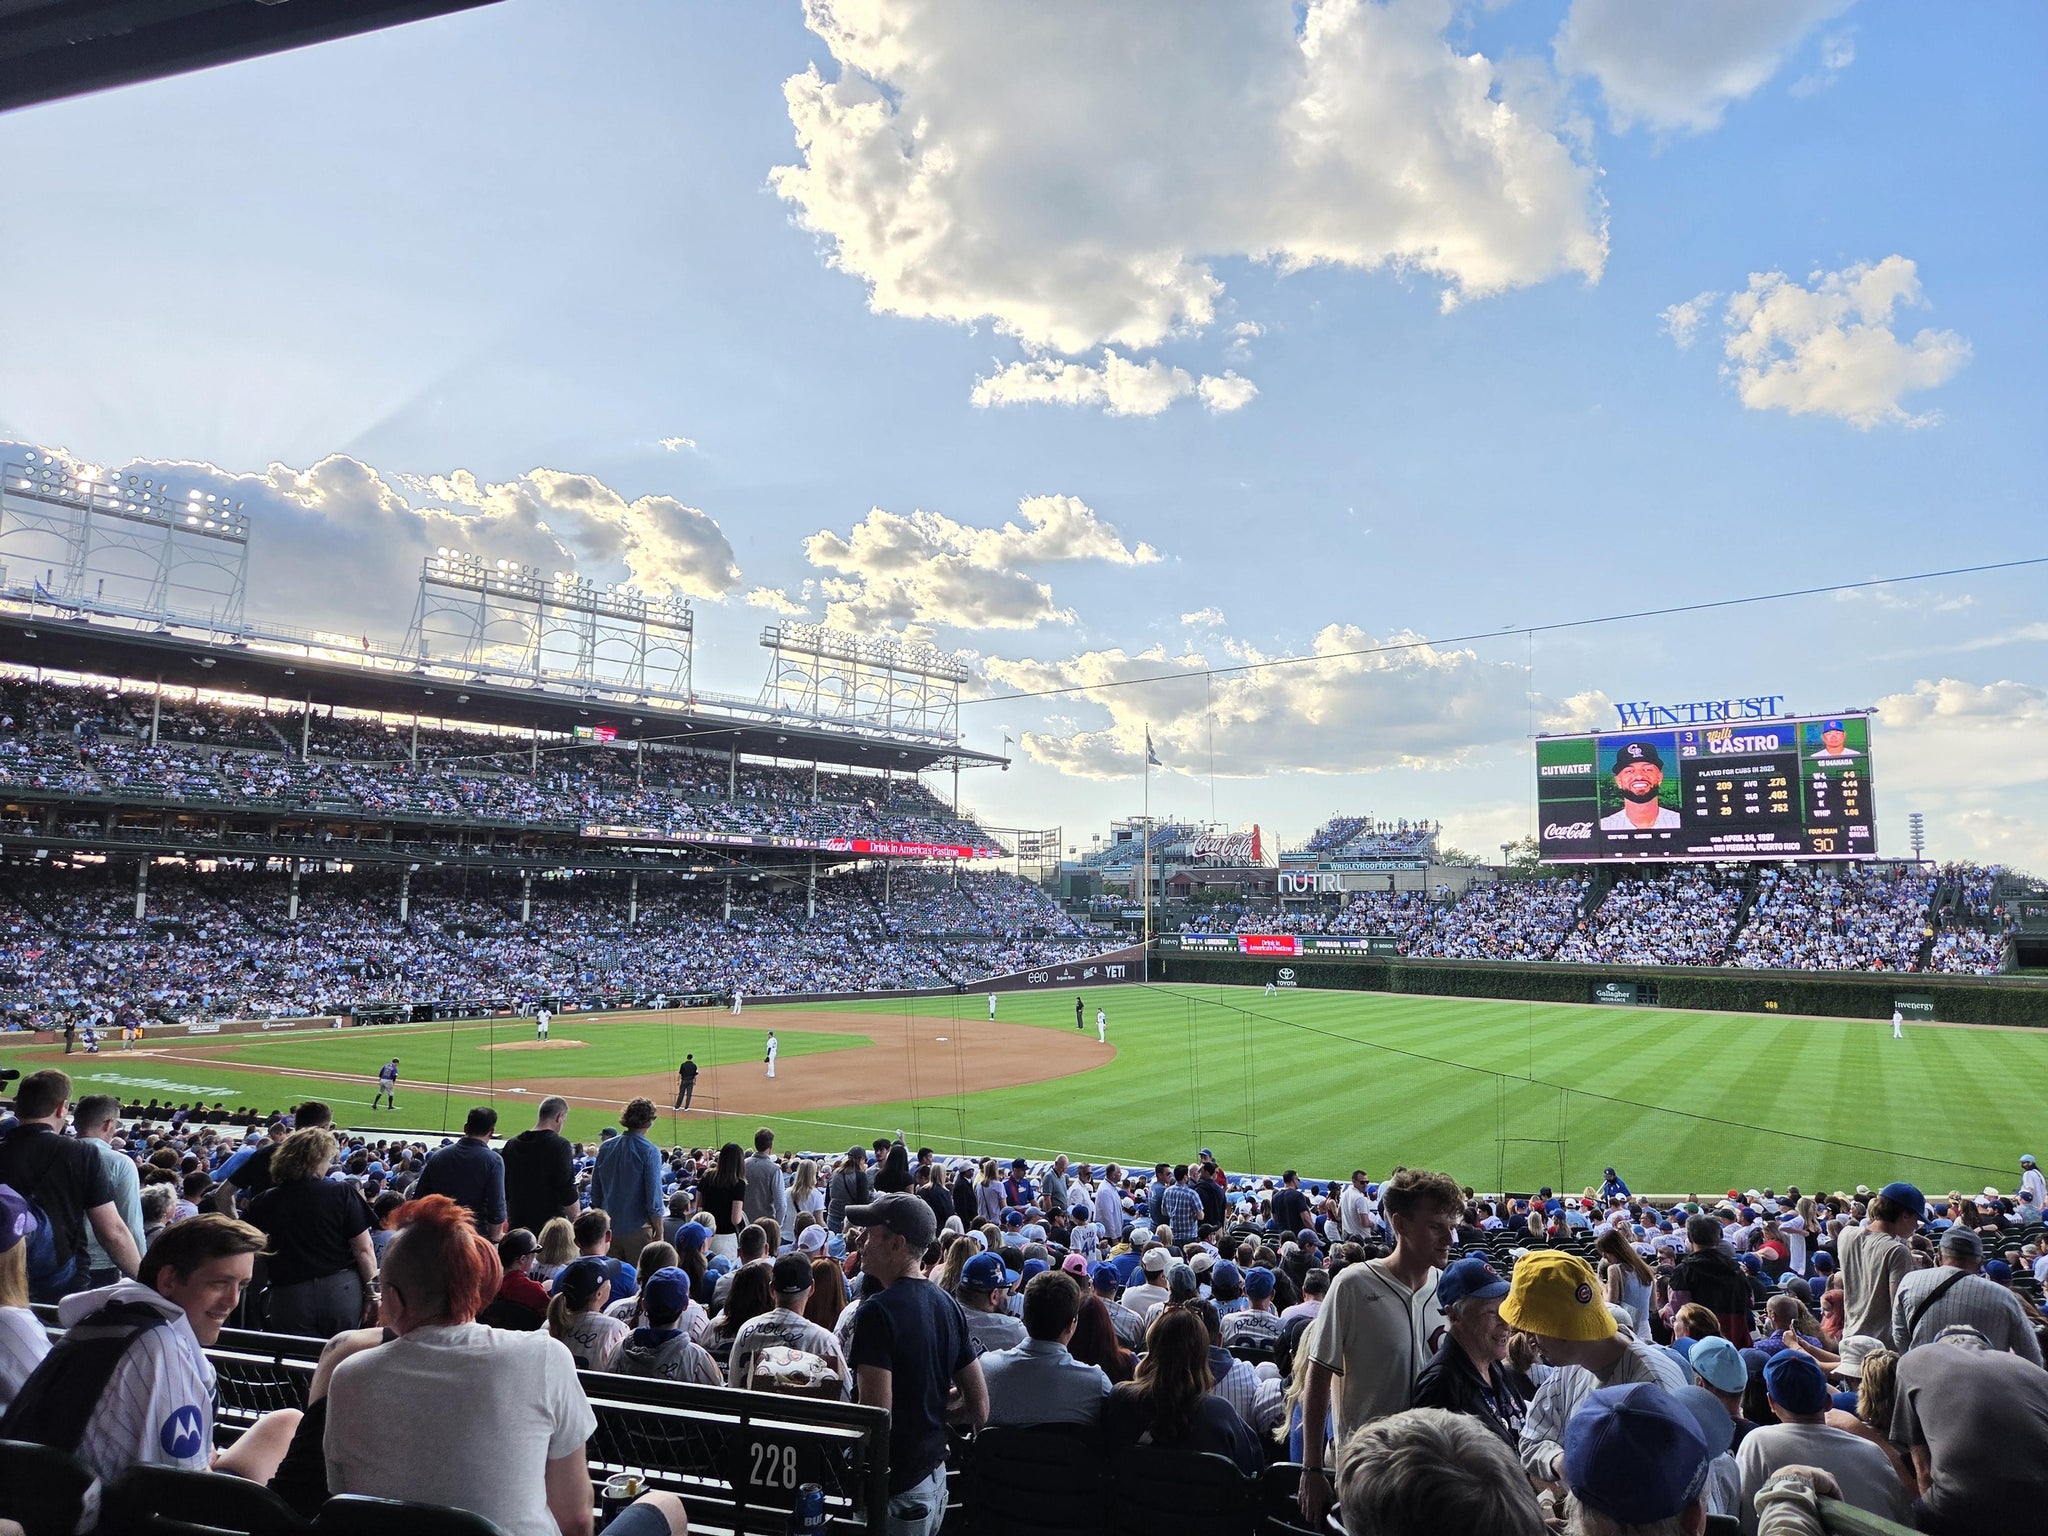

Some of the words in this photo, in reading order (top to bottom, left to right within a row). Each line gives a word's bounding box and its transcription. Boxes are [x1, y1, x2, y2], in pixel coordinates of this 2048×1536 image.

[1615, 695, 1784, 727] WINTRUST
[1685, 732, 1693, 742] 3
[1710, 734, 1779, 754] CASTRO
[1682, 746, 1697, 757] 2B
[1541, 764, 1593, 776] CUTWATER
[1699, 769, 1722, 777] PLAYED
[1735, 767, 1751, 775] CUBS
[1716, 781, 1733, 791] 209
[1767, 777, 1787, 787] .278
[1813, 781, 1828, 789] ERA
[1722, 794, 1729, 803] 5
[1768, 790, 1788, 800] .402
[1769, 803, 1789, 813] .752
[1543, 822, 1594, 840] Coca-Cola
[1723, 834, 1743, 842] APRIL
[870, 843, 890, 853] Drink
[890, 843, 899, 853] in
[899, 844, 932, 855] America's
[933, 846, 959, 857] Pastime
[1756, 843, 1783, 851] PUERTO
[1783, 842, 1800, 851] RICO
[1813, 838, 1834, 853] 90
[1330, 862, 1416, 870] WRIGLEYROOFTOPS.COM
[1160, 938, 1179, 946] Harvey
[1261, 939, 1275, 947] Drink
[1028, 971, 1049, 984] eero
[1105, 964, 1126, 979] YETI
[1596, 989, 1630, 999] Gallagher
[1894, 1000, 1934, 1011] Invenergy
[1082, 1240, 1096, 1256] 44
[740, 1321, 804, 1348] proud
[750, 1442, 797, 1490] 228
